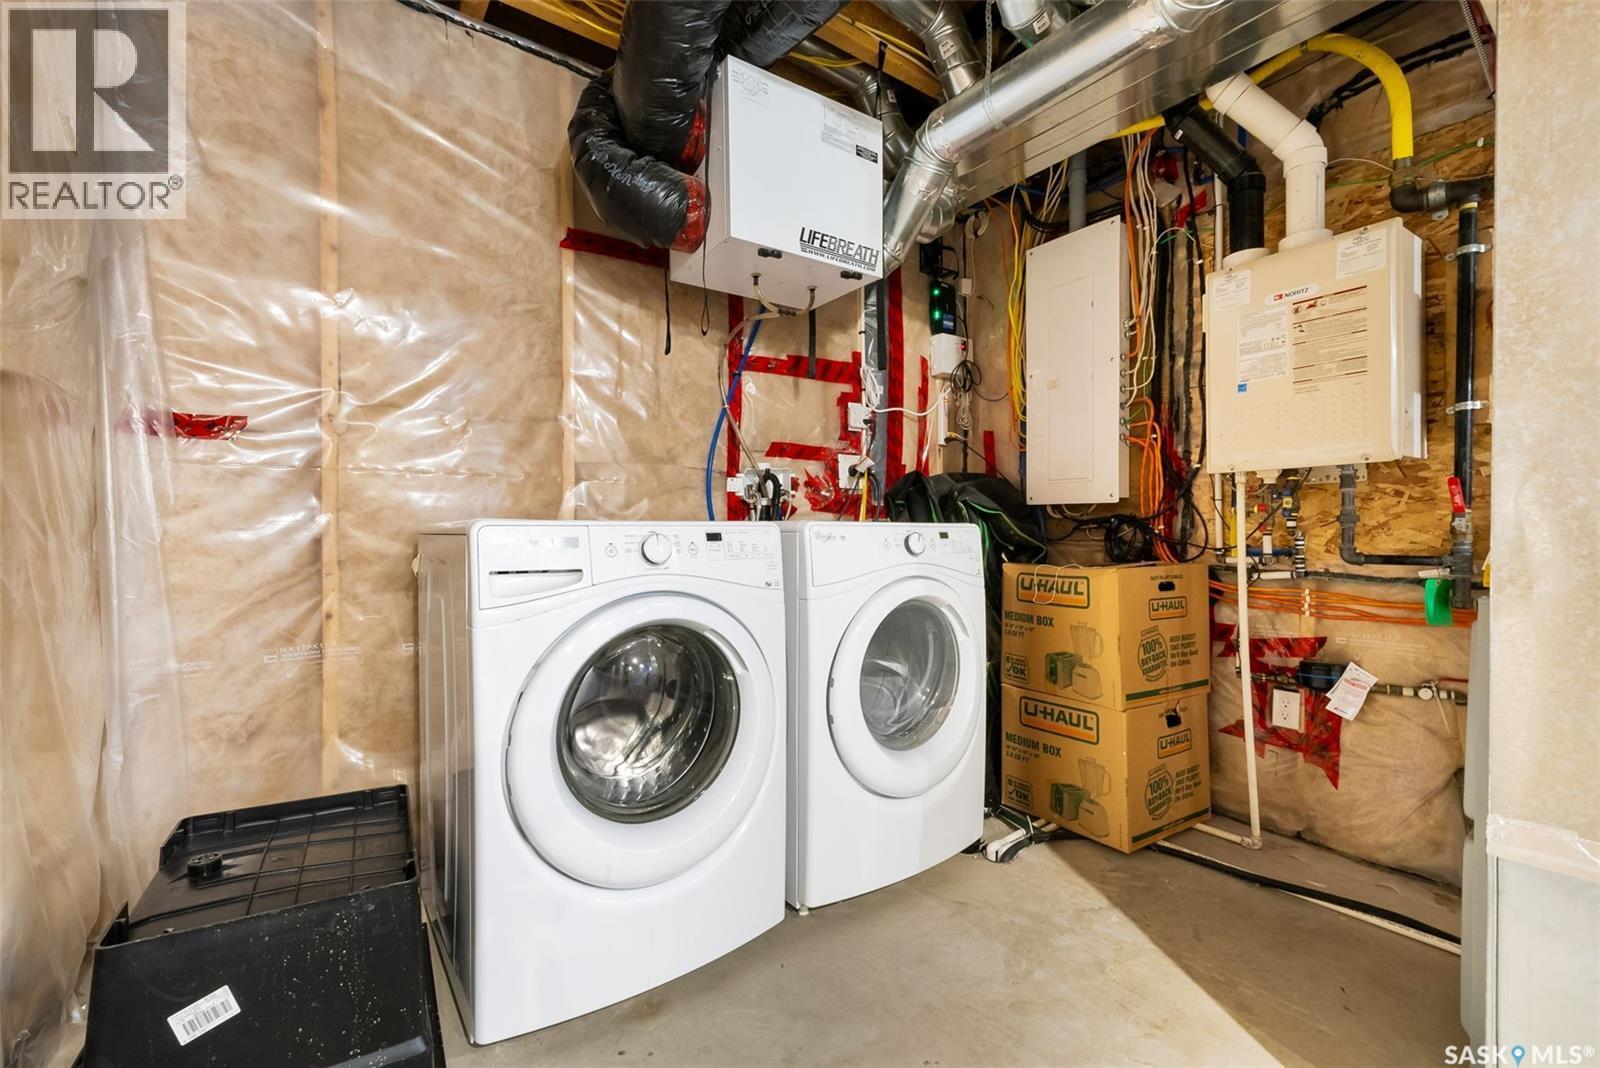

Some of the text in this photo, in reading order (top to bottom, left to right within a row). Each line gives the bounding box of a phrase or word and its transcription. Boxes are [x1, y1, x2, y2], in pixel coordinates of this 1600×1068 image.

[800, 227, 879, 264] LIFEBREATH
[1284, 287, 1310, 298] NORITZ
[1021, 577, 1084, 596] U-HAUL
[1151, 599, 1185, 612] U-HAUL
[1004, 610, 1034, 625] MEDIUM
[1036, 615, 1055, 628] BOX
[1141, 637, 1163, 655] 100%
[1024, 701, 1094, 732] U-HAUL
[1006, 731, 1040, 752] MEDIUM
[1043, 743, 1063, 759] BOX
[1160, 732, 1190, 750] U-HAUL
[1148, 776, 1169, 796] 100%
